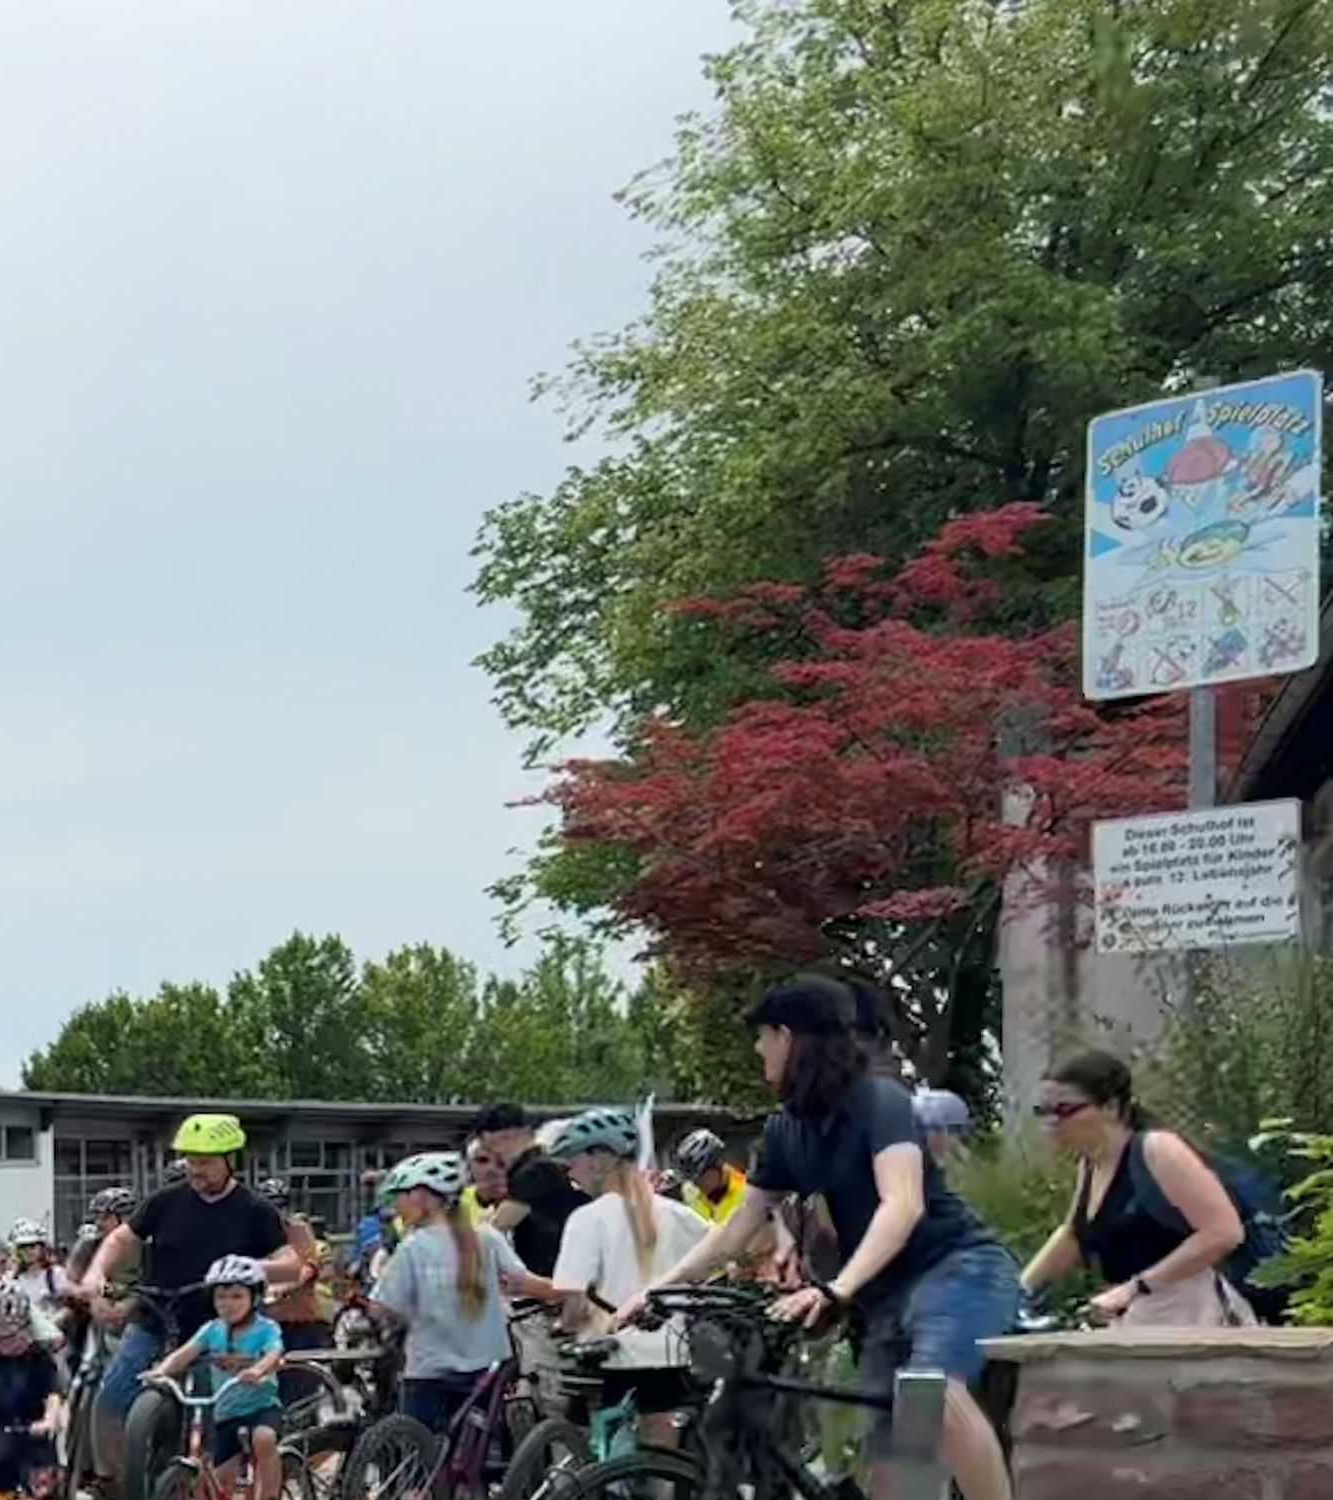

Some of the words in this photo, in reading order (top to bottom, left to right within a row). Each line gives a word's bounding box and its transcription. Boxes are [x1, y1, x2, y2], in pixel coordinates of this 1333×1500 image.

[1170, 818, 1234, 836] Schulhof
[1122, 844, 1139, 858] ab
[1229, 833, 1255, 846] Uhr
[1134, 855, 1200, 873] Spielplatz
[1203, 851, 1224, 864] für
[1228, 848, 1275, 862] Kinder
[1192, 866, 1273, 882] Lebensjahr
